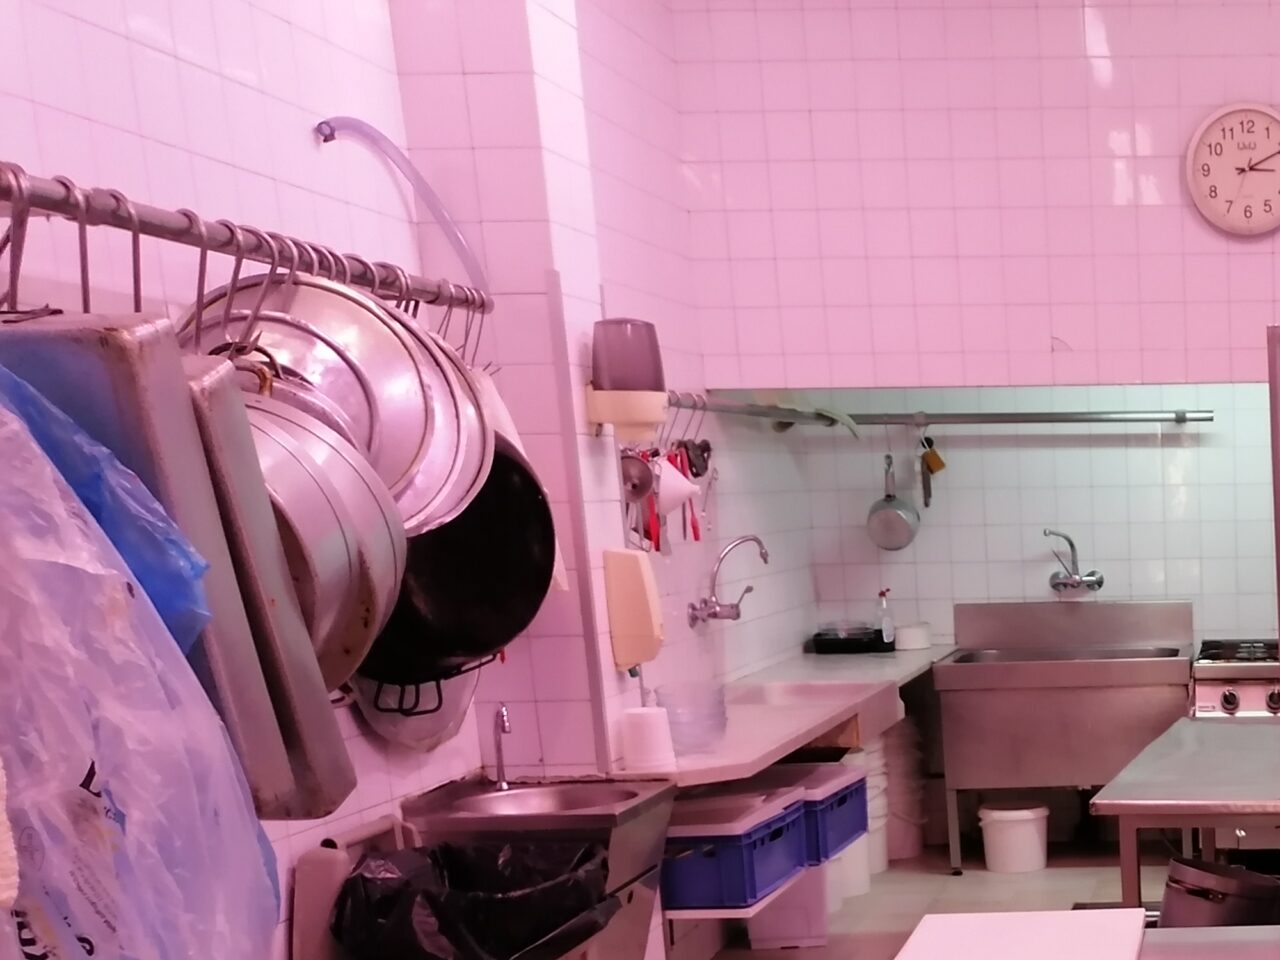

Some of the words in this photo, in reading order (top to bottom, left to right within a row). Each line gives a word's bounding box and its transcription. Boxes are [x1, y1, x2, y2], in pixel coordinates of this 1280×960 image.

[1221, 127, 1234, 140] 11
[1239, 119, 1255, 134] 12
[1265, 126, 1270, 139] 1
[1207, 142, 1223, 156] 10
[1201, 163, 1211, 177] 9
[1208, 184, 1218, 199] 8
[1225, 200, 1233, 214] 7
[1243, 204, 1253, 219] 6
[1263, 199, 1272, 213] 5
